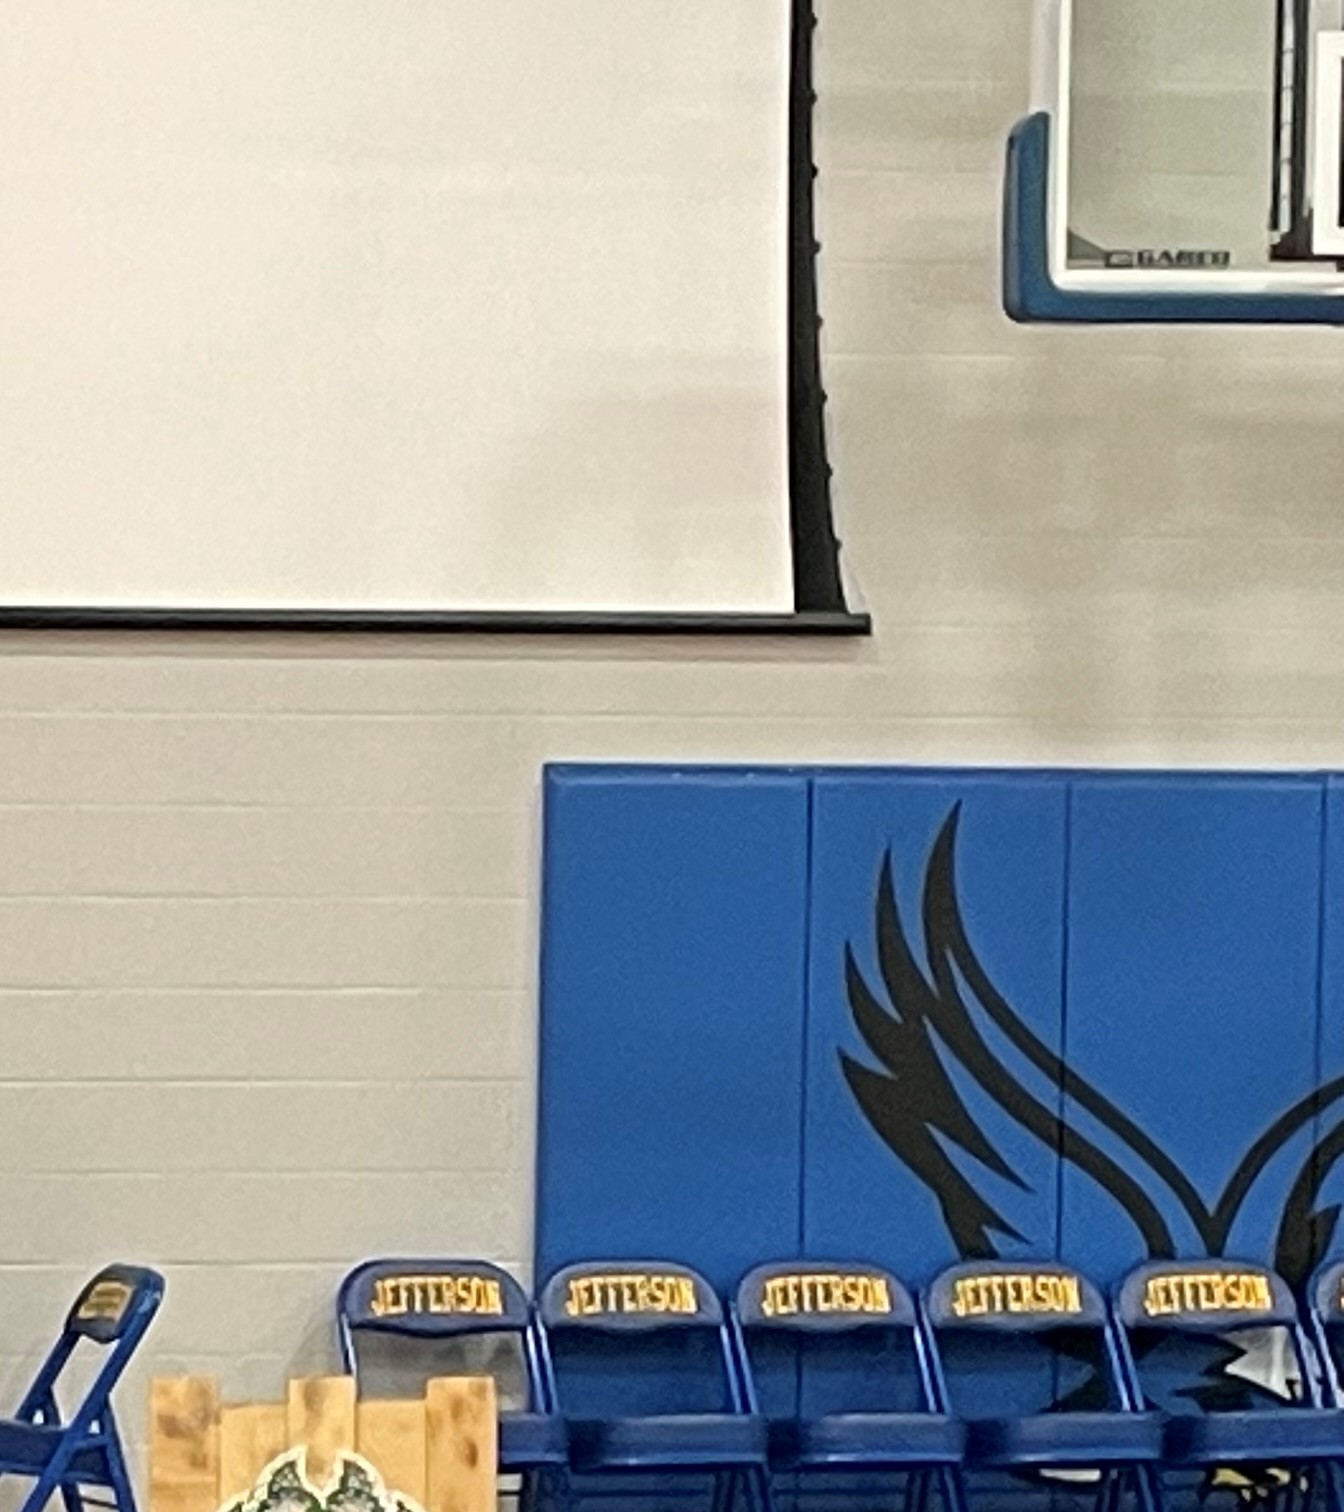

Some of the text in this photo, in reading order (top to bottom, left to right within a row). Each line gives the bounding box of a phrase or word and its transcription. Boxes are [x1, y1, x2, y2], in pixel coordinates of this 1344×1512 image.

[371, 1275, 503, 1317] JEFFERSON
[565, 1274, 698, 1317] JEFFERSON
[761, 1274, 892, 1317] JEFFERSON
[952, 1274, 1082, 1317] JEFFERSON
[1143, 1273, 1272, 1317] JEFFERSON
